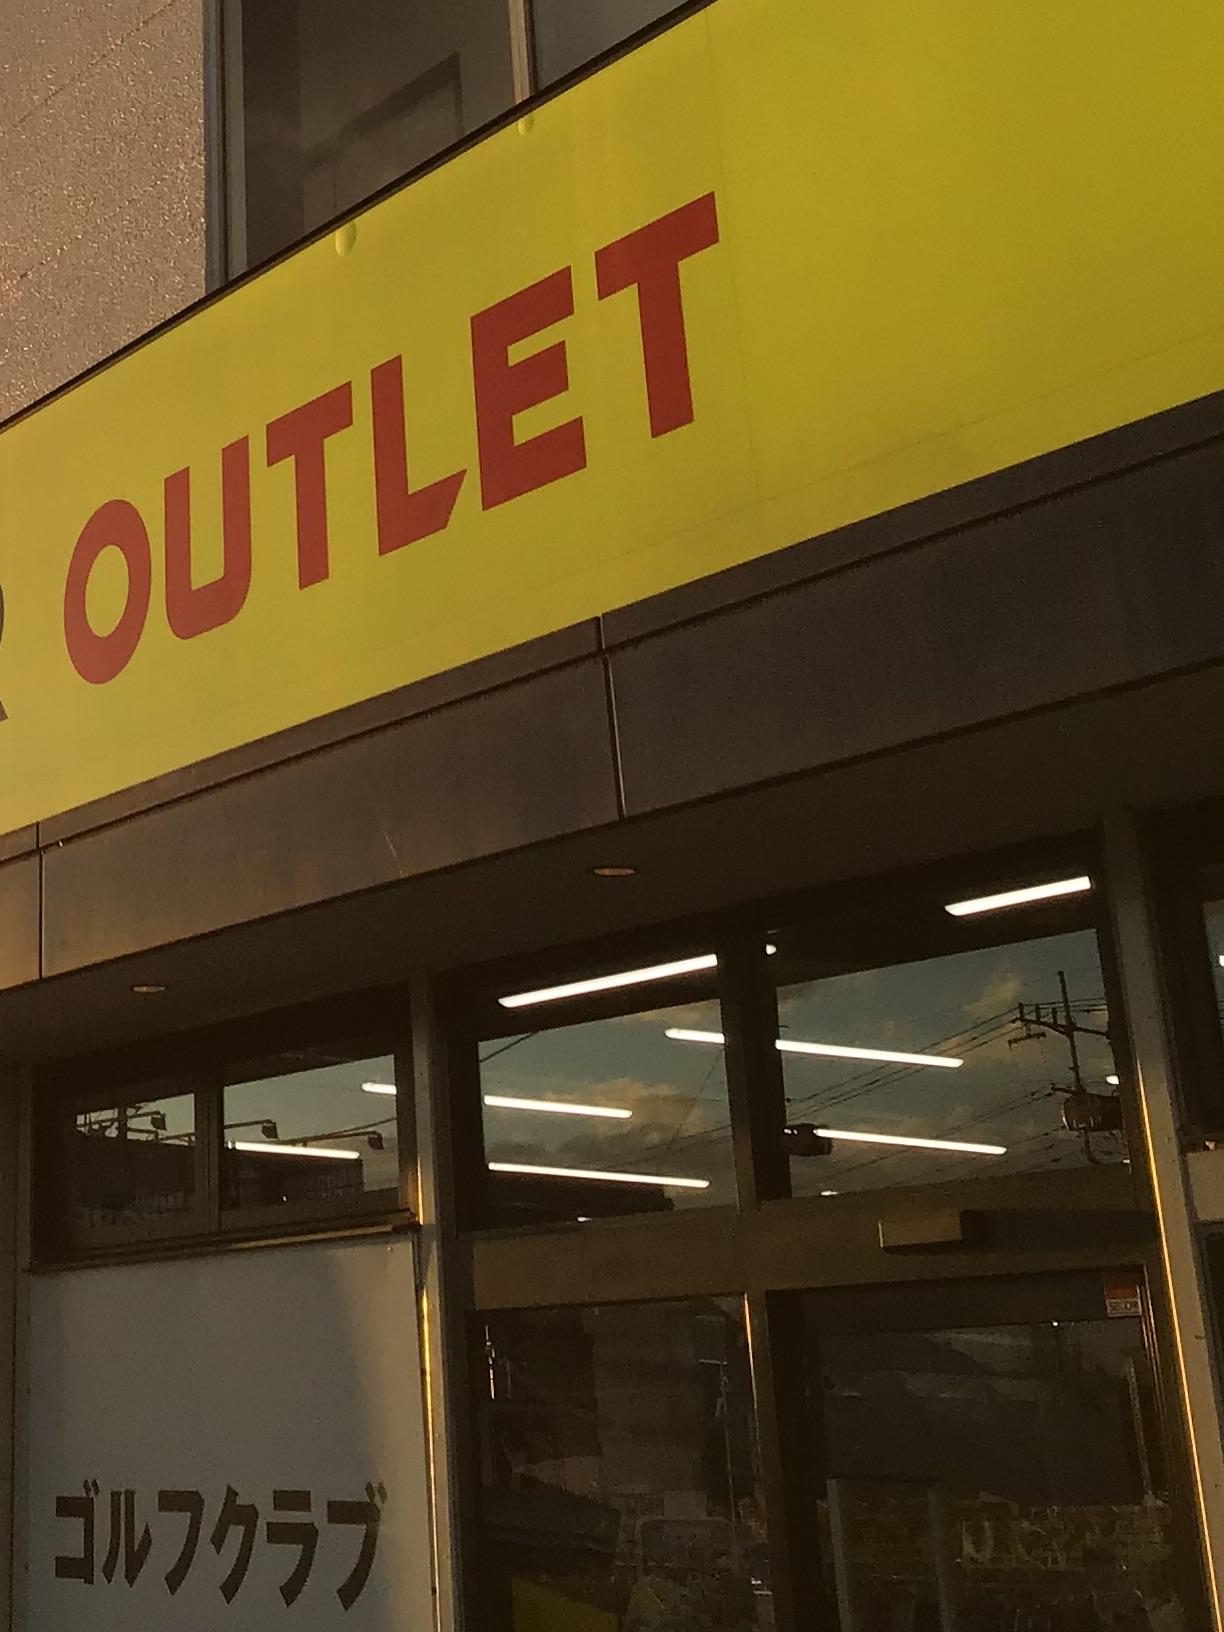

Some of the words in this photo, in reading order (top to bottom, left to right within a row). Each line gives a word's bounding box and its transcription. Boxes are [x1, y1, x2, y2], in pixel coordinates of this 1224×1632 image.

[63, 191, 719, 685] OUTLET
[54, 1478, 388, 1612] ゴルフクラブ
